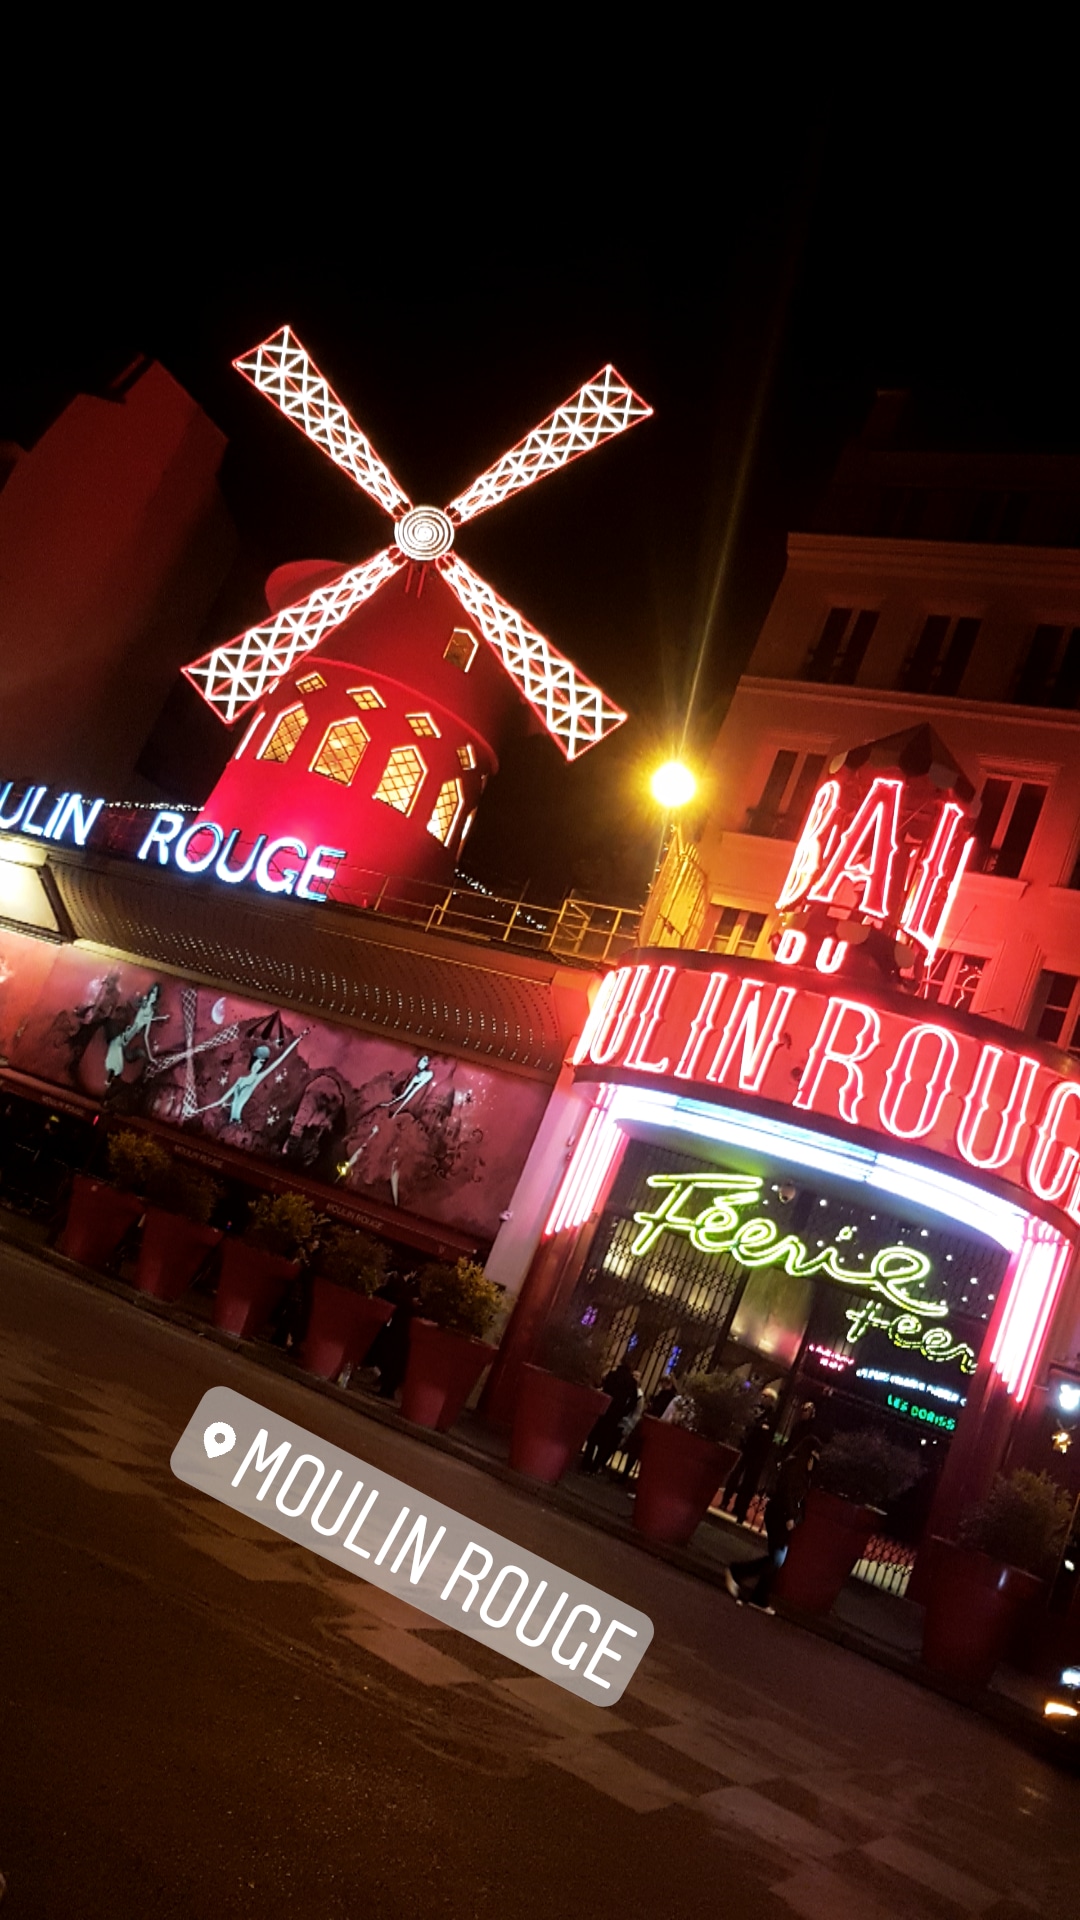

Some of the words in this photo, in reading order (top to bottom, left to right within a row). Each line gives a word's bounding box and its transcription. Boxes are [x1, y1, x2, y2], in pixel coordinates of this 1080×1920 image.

[138, 811, 347, 902] ROUGE
[775, 777, 975, 955] BAL
[775, 929, 848, 974] DU
